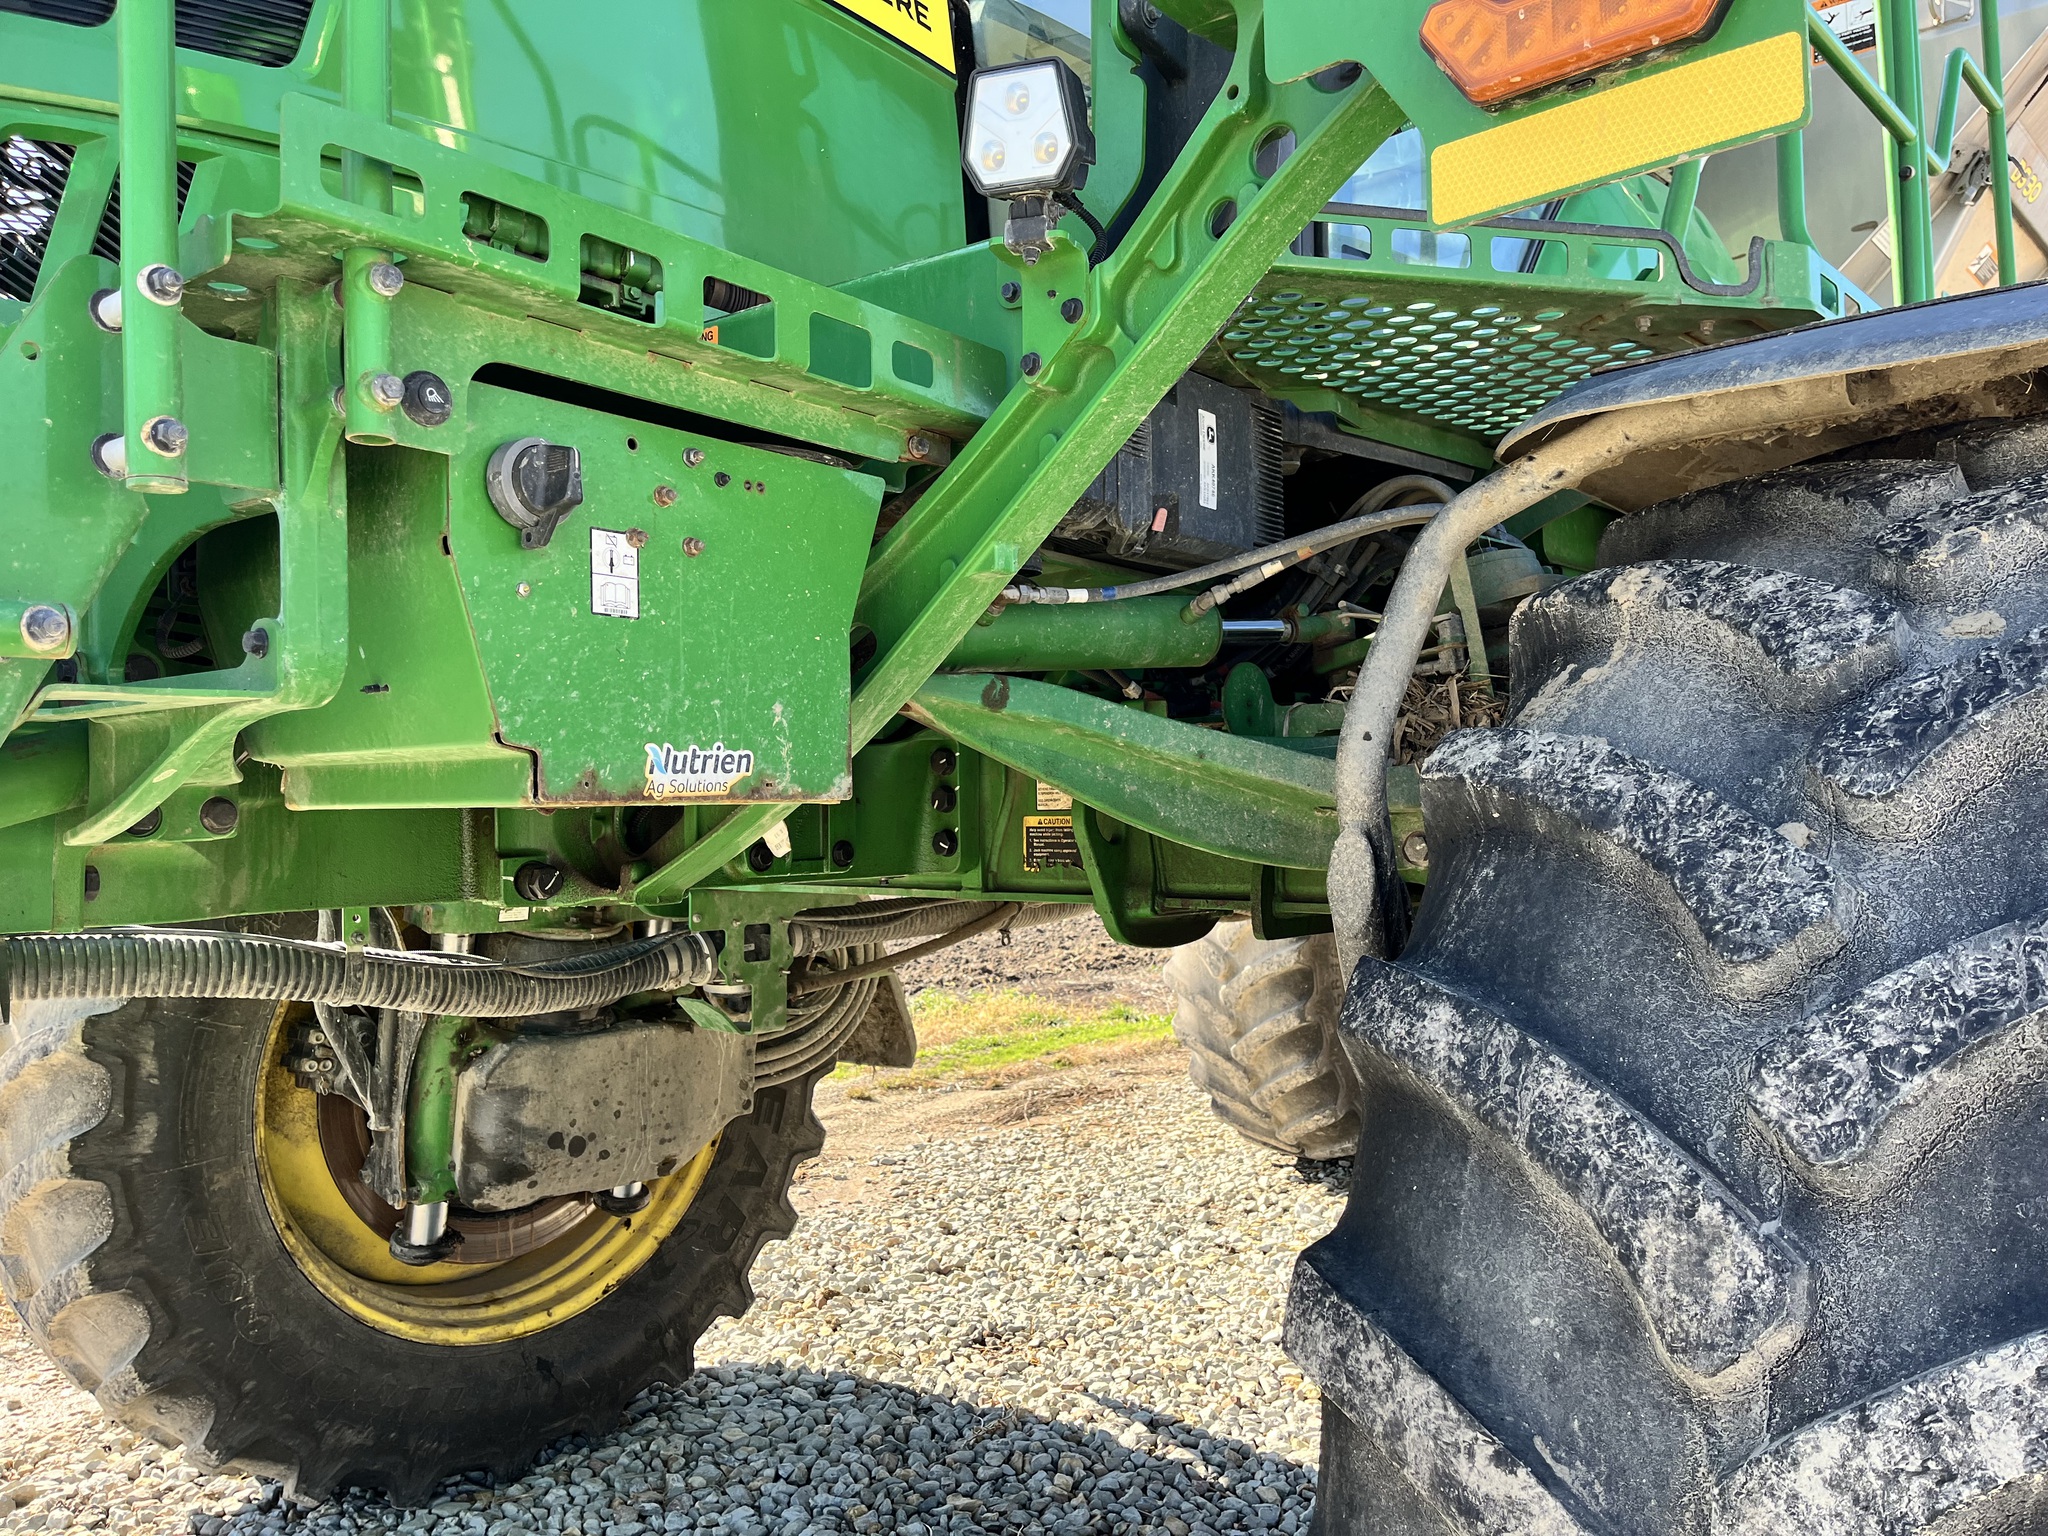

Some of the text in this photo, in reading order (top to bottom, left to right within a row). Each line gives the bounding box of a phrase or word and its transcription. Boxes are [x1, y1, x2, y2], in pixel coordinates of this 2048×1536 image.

[648, 745, 752, 775] Nutrien
[646, 779, 728, 797] Ag Solutions
